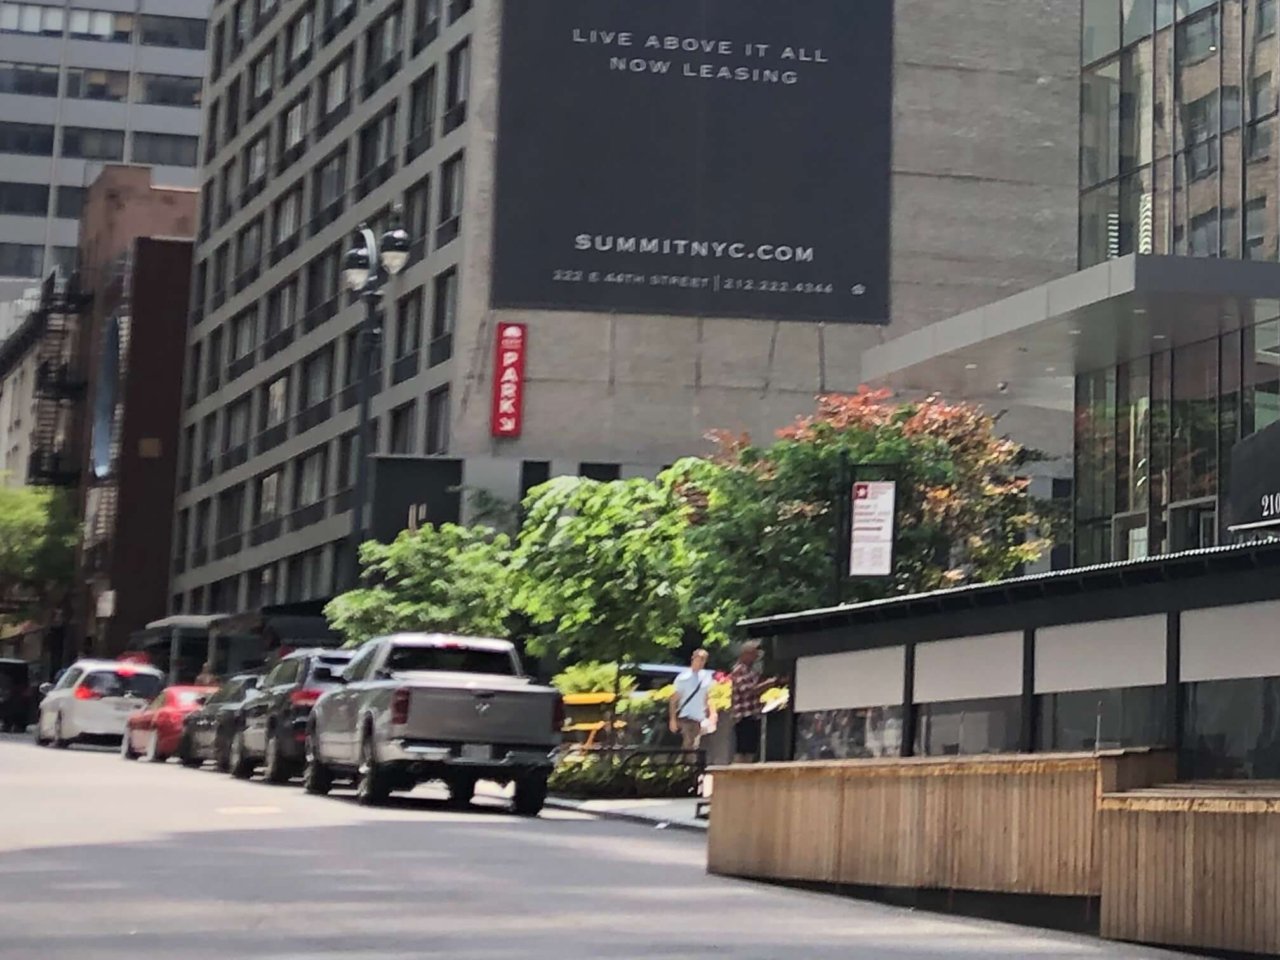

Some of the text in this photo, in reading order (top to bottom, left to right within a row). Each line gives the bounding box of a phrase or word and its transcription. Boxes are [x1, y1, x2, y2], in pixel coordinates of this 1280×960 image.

[573, 28, 828, 62] LIVE ABOVE IT ALL
[609, 56, 799, 85] NOW LEASING
[574, 234, 814, 263] SUMMITNYC.COM
[552, 269, 583, 282] 222
[604, 273, 645, 285] 44TH
[649, 274, 709, 288] STREET
[499, 351, 519, 414] PARK
